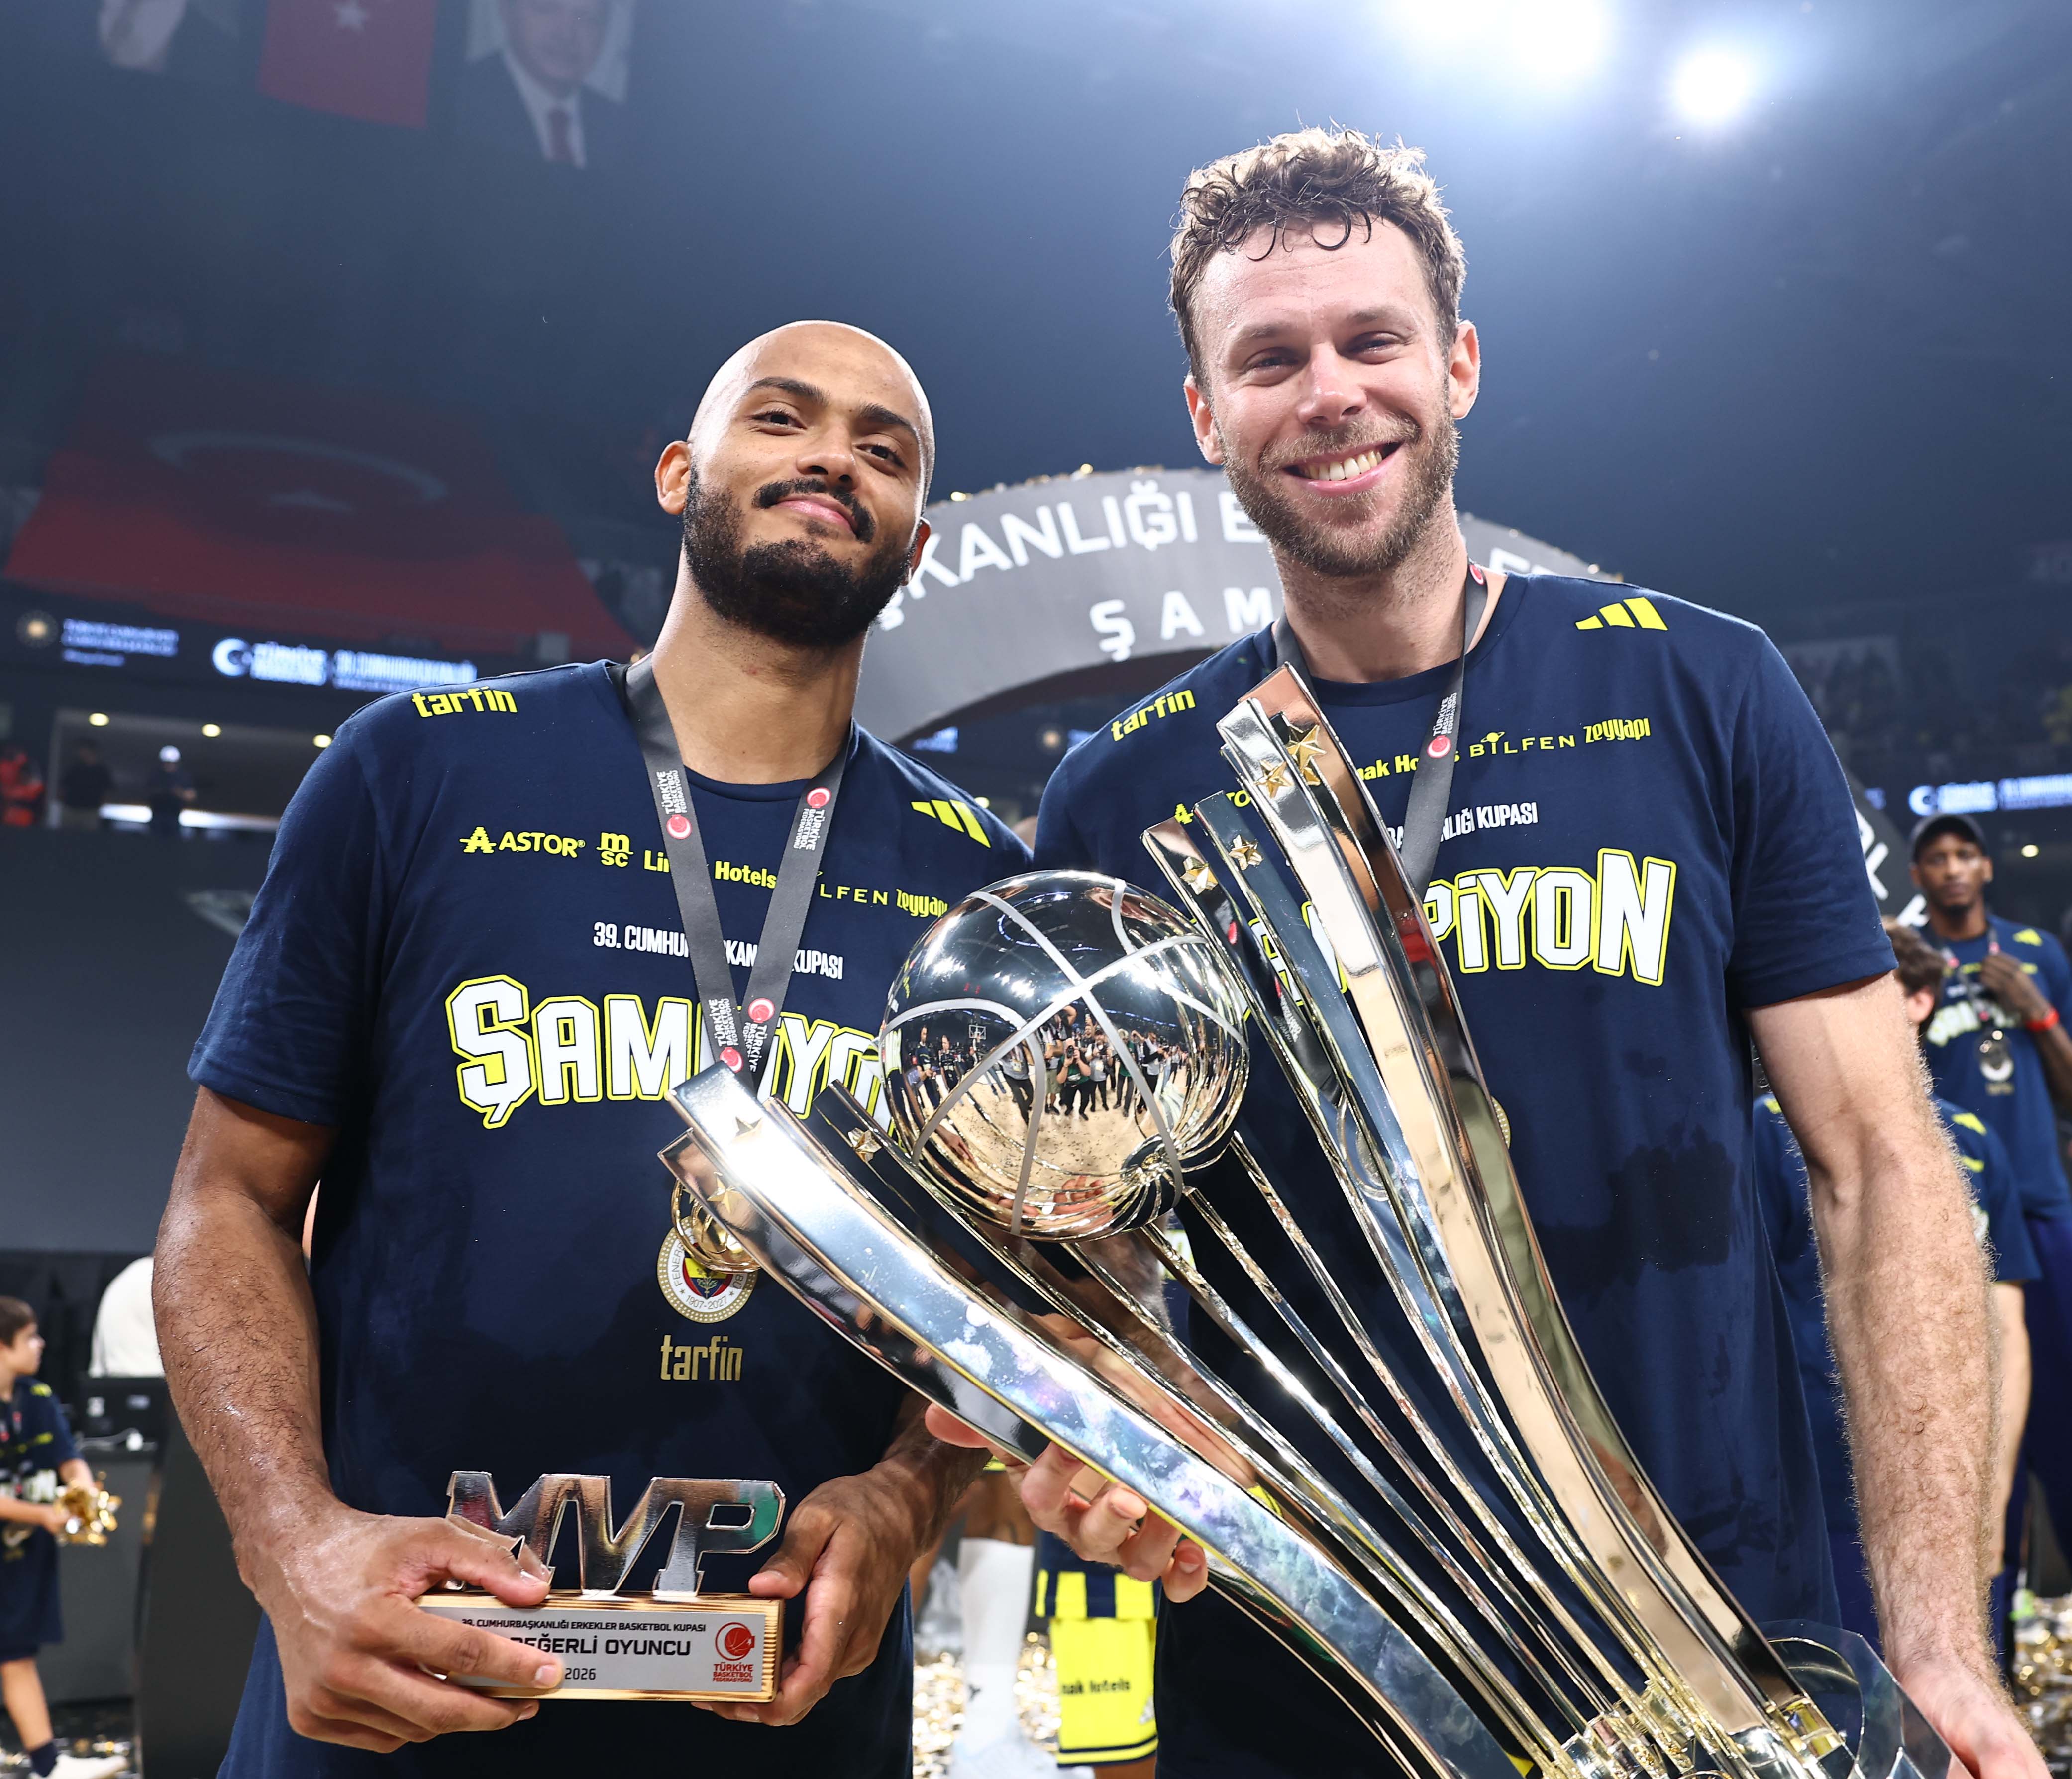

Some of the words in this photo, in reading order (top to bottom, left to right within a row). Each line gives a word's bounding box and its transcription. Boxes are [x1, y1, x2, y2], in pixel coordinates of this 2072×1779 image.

[412, 686, 518, 718] tarfin
[1111, 689, 1196, 741] tarfin
[1432, 696, 1449, 736] TÜRKİYE
[656, 771, 675, 815] TÜRKİYE
[666, 770, 682, 814] BASKETBOL
[672, 770, 688, 813] FEDERASYONU
[793, 808, 810, 849] FEDERASYONU
[799, 809, 816, 850] BASKETBOL
[806, 809, 826, 851] TÜRKİYE
[1476, 802, 1538, 829] KUPASI
[715, 860, 777, 889] Hotels
[593, 922, 621, 948] 39.
[708, 999, 727, 1047] TÜRKİYE
[718, 998, 734, 1046] BASKETBOL
[686, 1294, 727, 1310] 1907-2027
[660, 1335, 743, 1381] tarfin
[444, 1470, 786, 1597] MVP
[477, 1619, 569, 1629] CUMHURBAŞKANLIĞI
[571, 1621, 617, 1630] ERKEKLER
[619, 1622, 671, 1631] BASKETBOL
[605, 1639, 691, 1656] OYUNCU
[714, 1662, 754, 1672] TÜRKİYE
[565, 1668, 597, 1680] 2026
